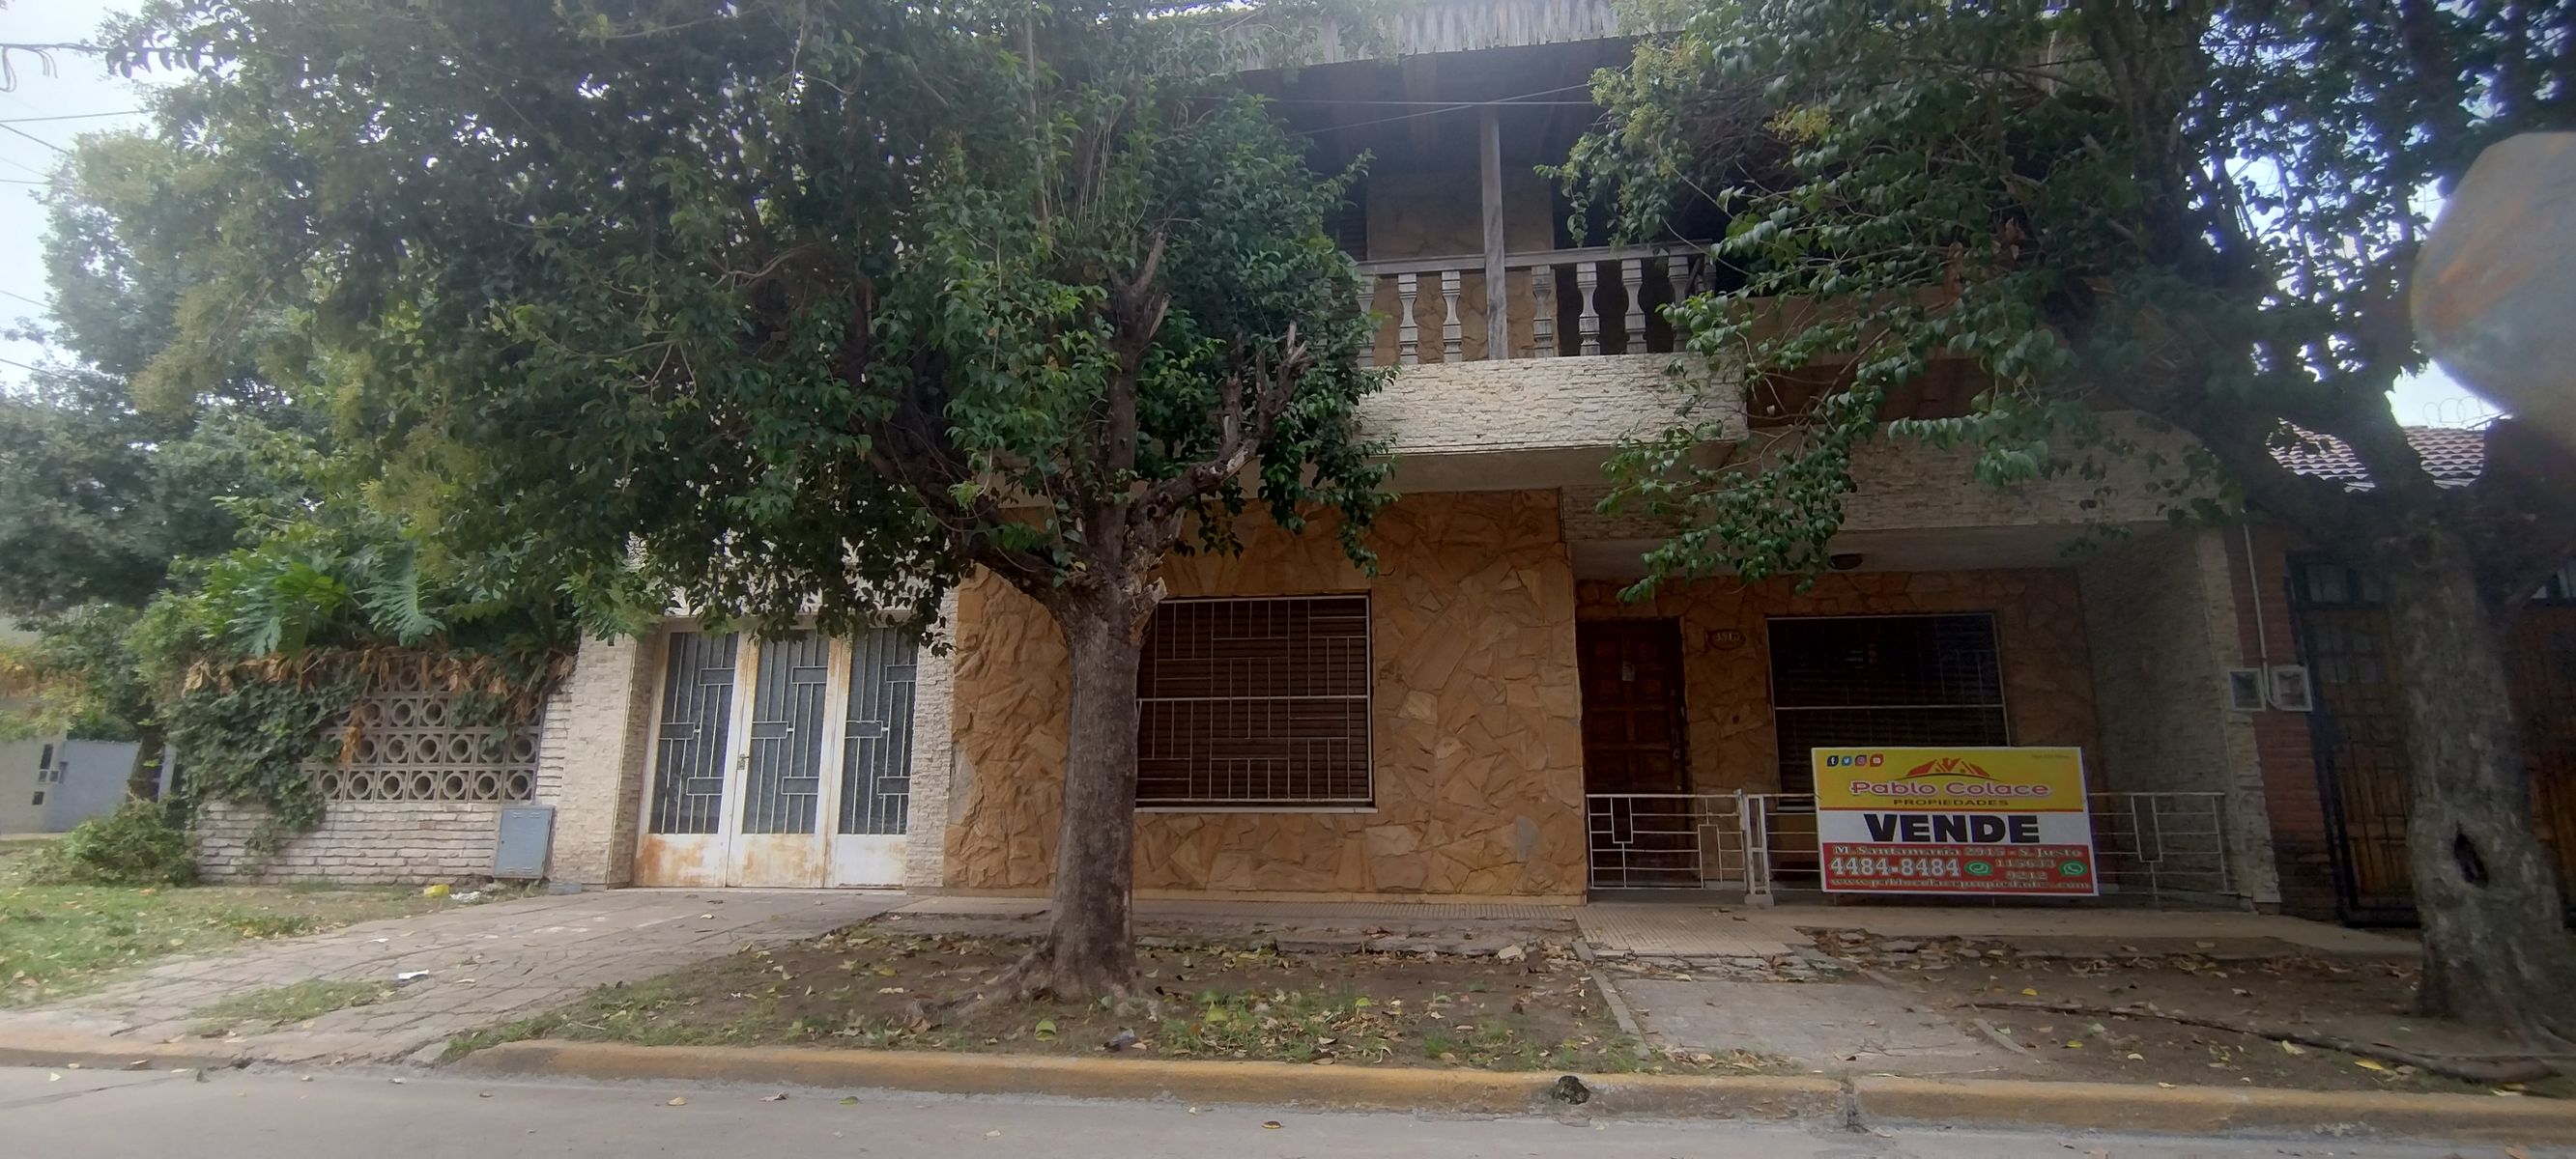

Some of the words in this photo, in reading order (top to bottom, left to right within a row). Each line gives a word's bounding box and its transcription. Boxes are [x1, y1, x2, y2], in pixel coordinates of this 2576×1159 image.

[1850, 780, 1937, 796] Pablo
[1945, 782, 2050, 797] Colace
[1863, 813, 2041, 843] VENDE
[1830, 858, 1961, 877] 4484-8484
